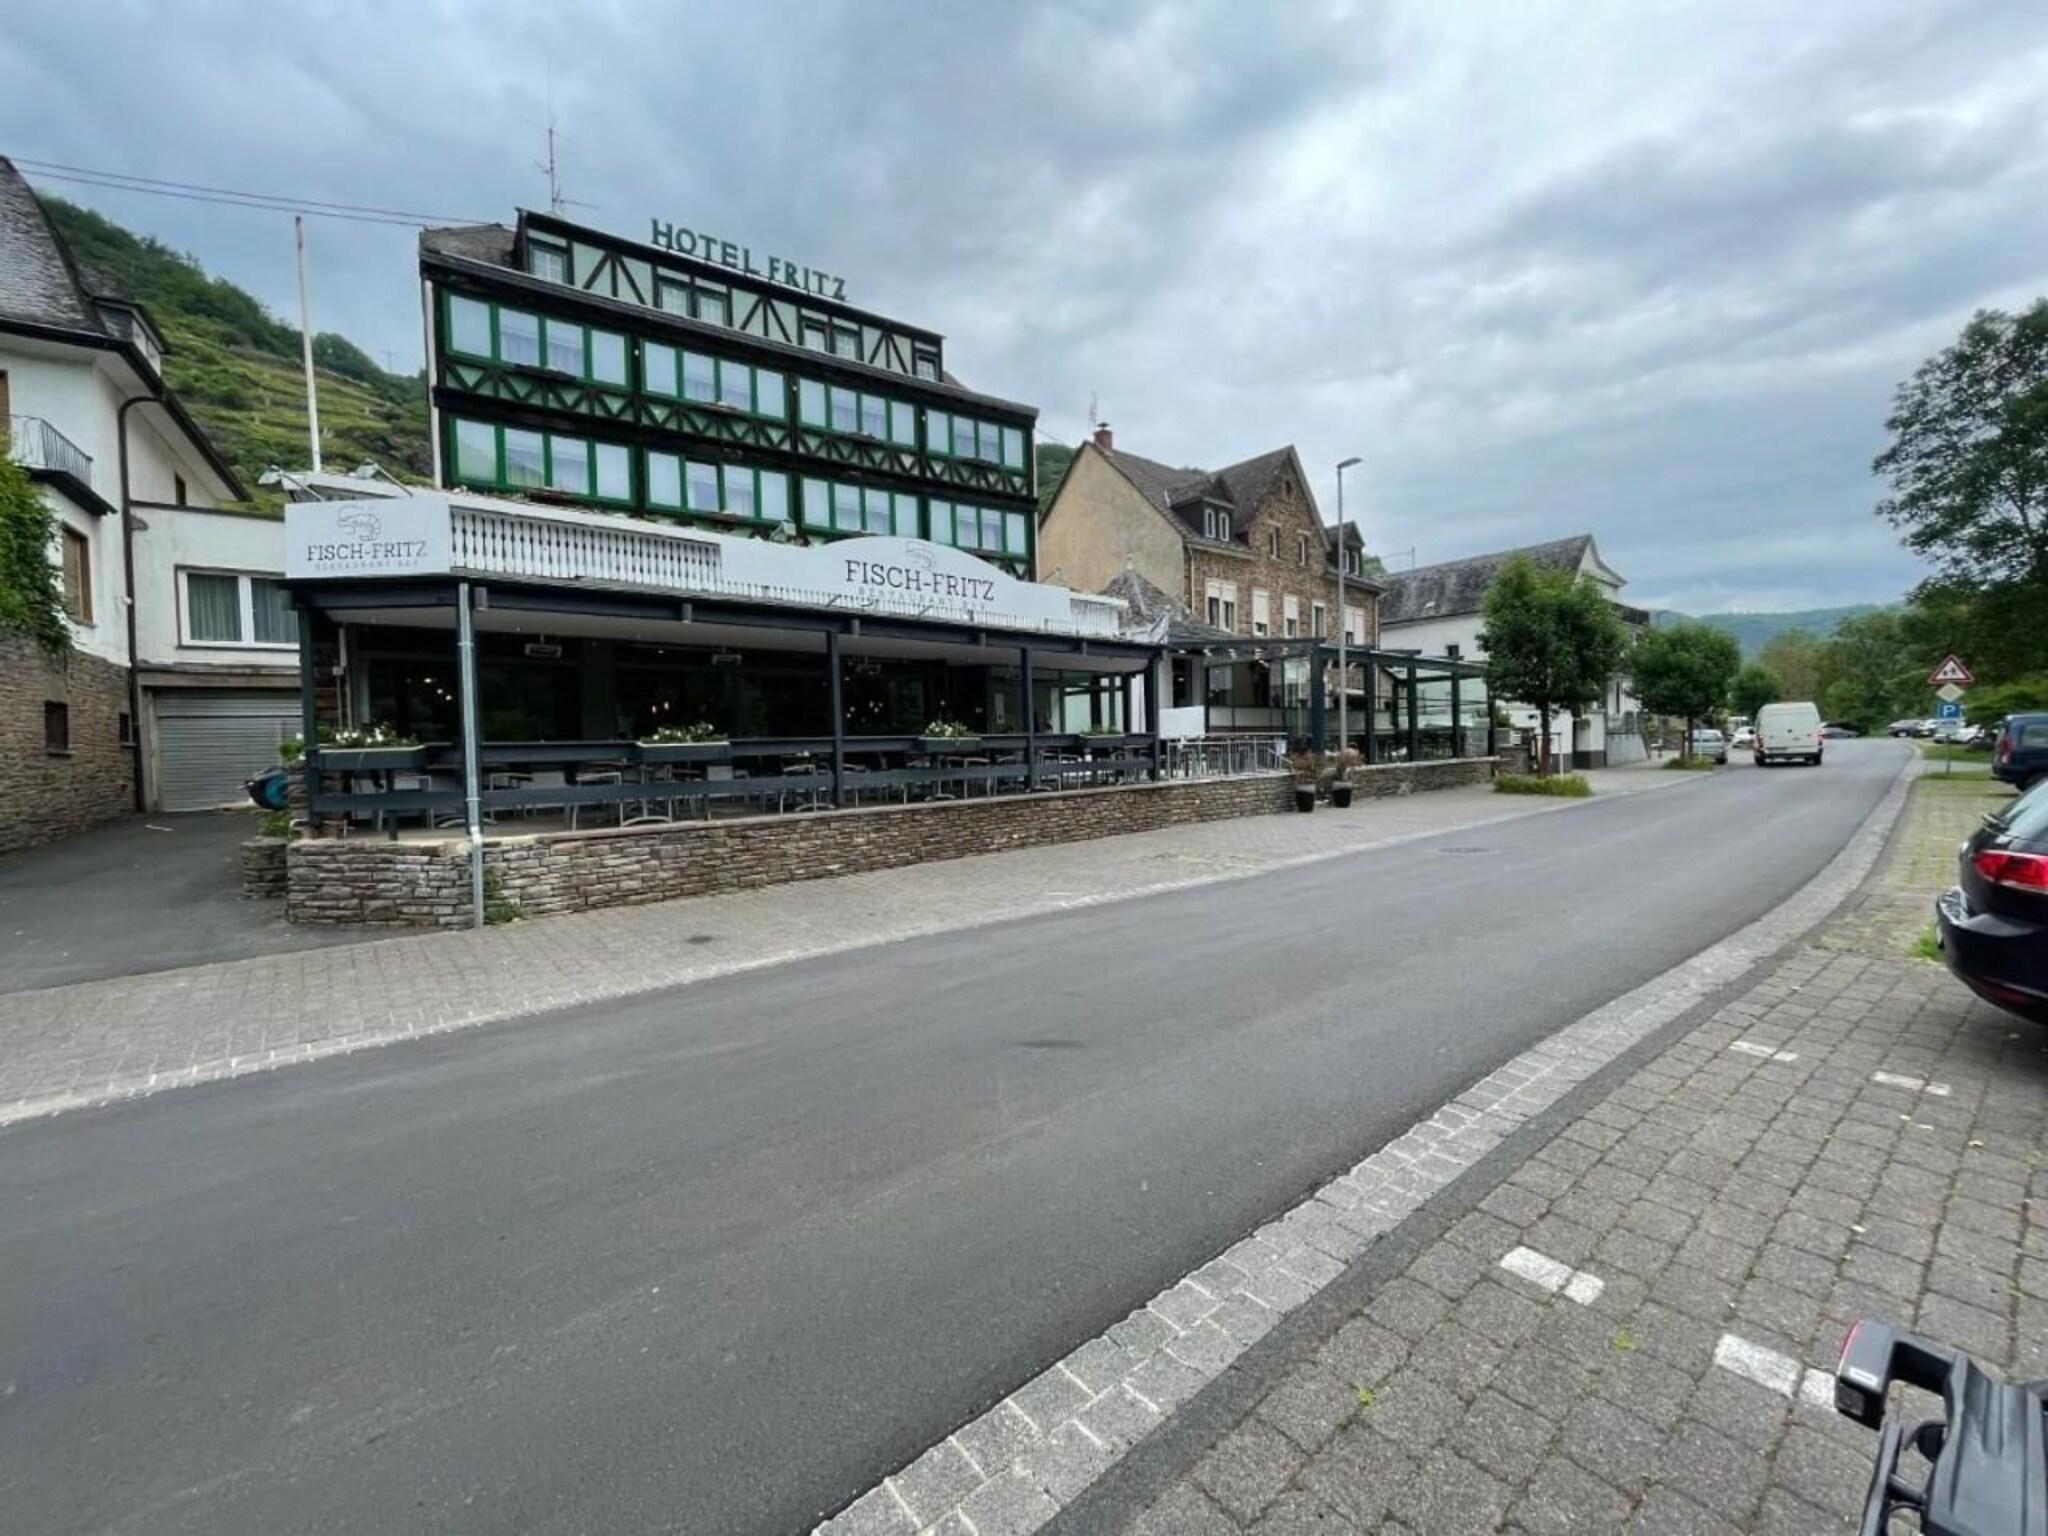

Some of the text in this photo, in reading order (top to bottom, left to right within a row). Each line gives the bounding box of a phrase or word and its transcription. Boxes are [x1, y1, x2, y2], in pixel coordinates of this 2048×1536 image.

[651, 218, 847, 301] HOTEL FRITZ
[307, 541, 427, 561] FISCH-FRITZ
[845, 560, 994, 600] FISCH-FRITZ
[1944, 705, 1956, 717] P
